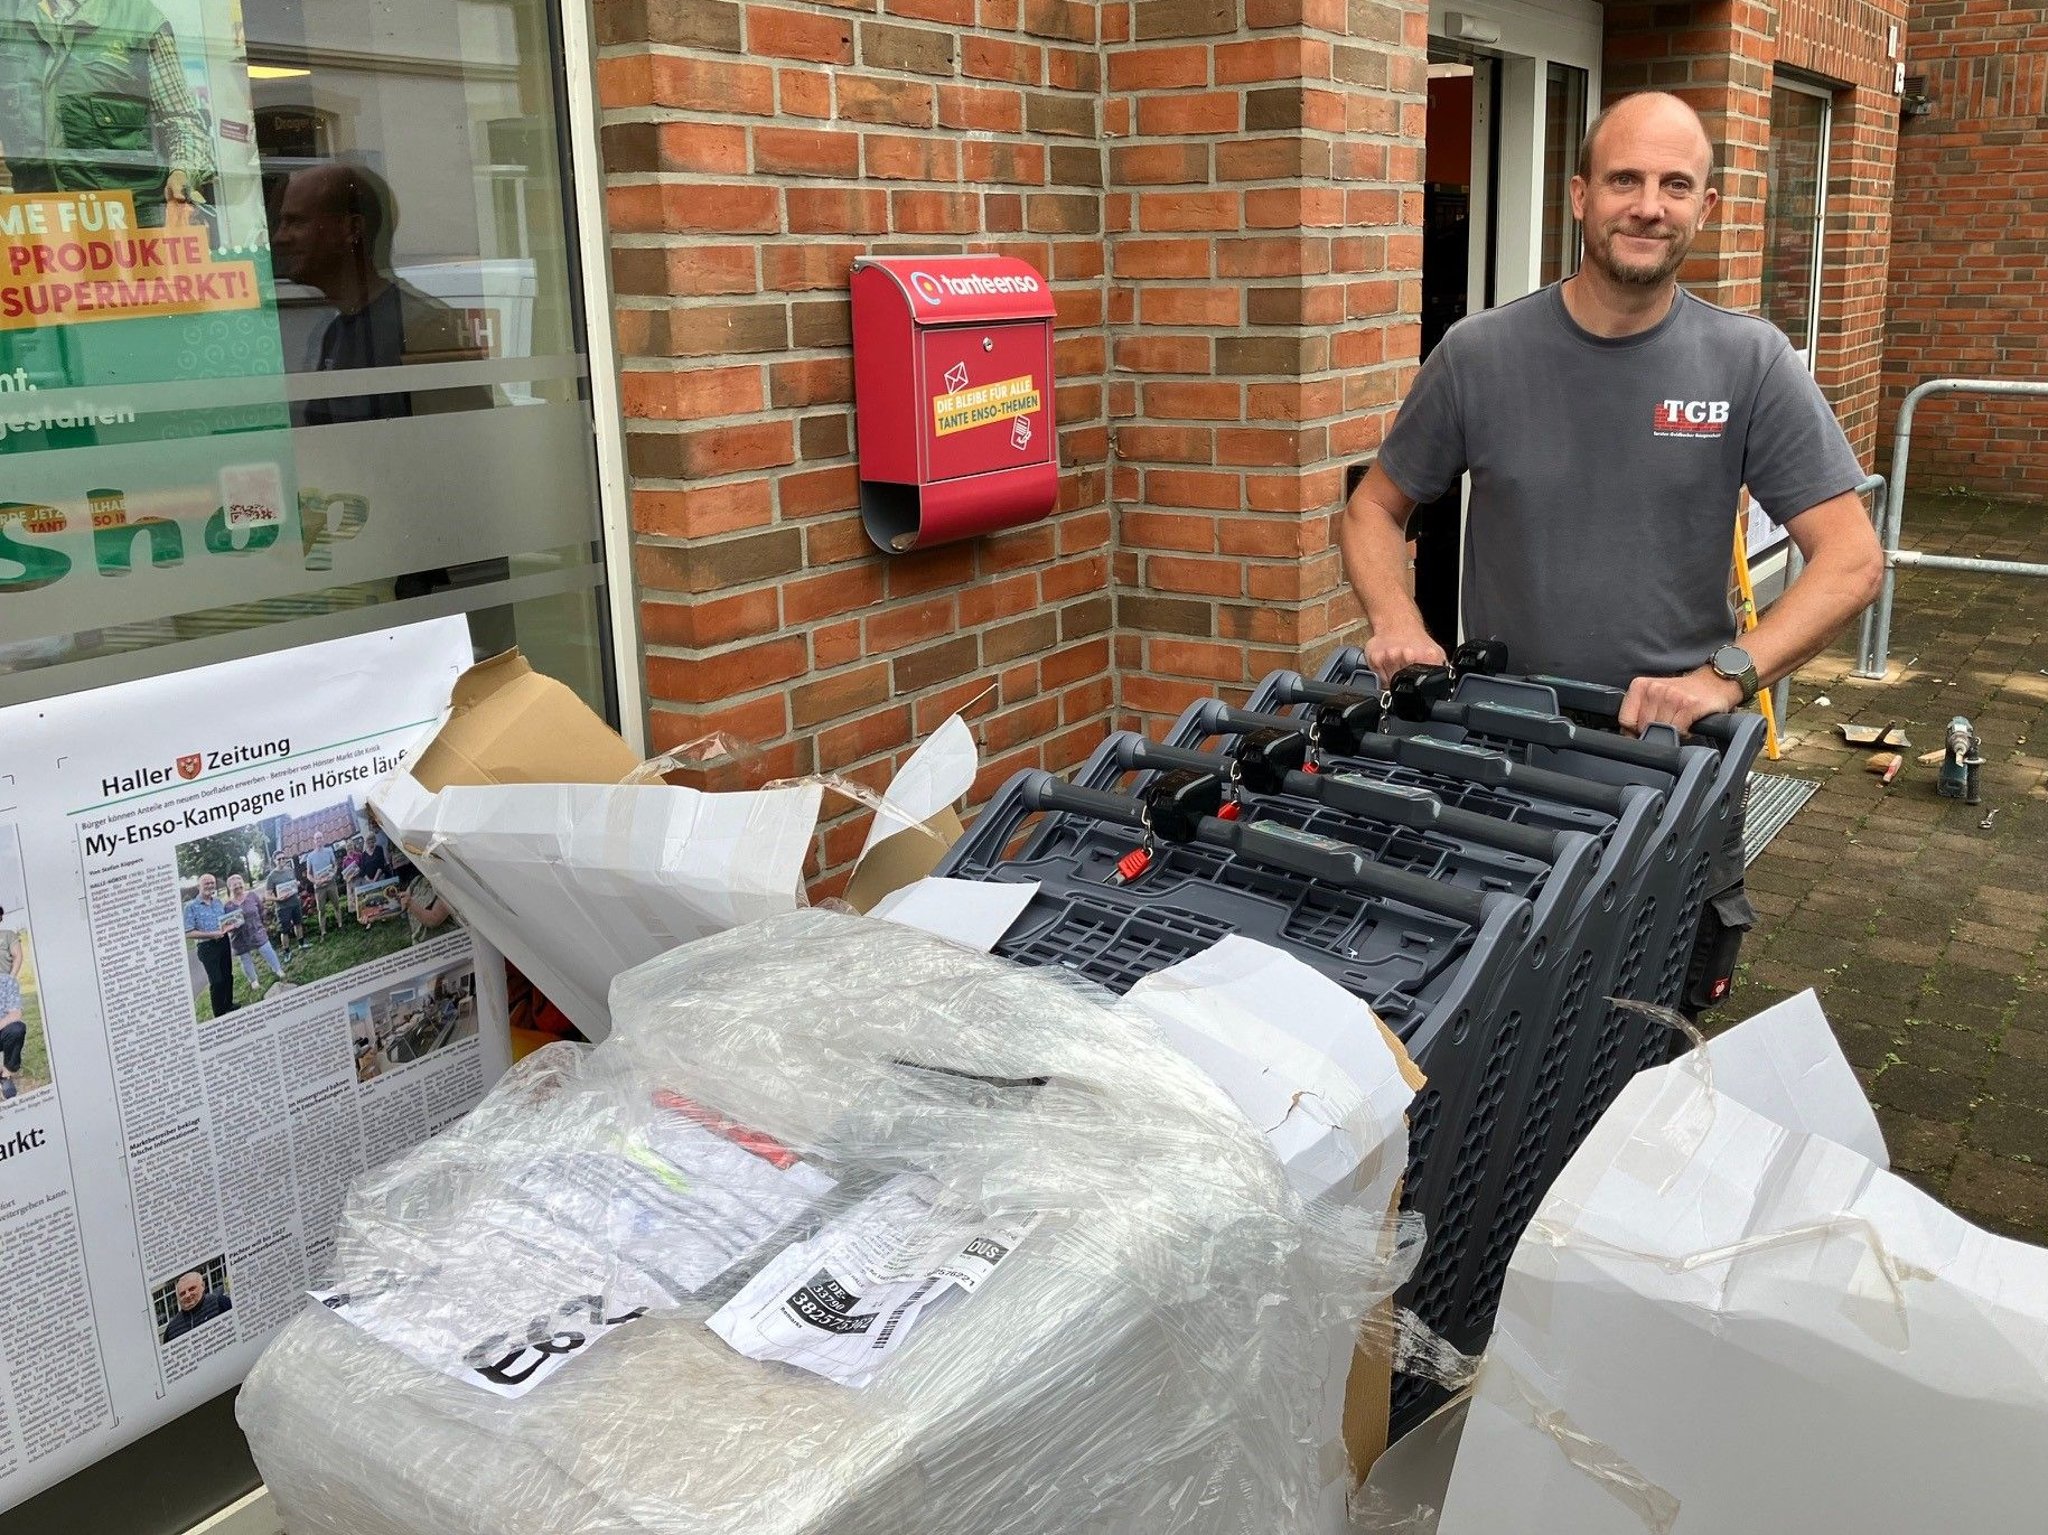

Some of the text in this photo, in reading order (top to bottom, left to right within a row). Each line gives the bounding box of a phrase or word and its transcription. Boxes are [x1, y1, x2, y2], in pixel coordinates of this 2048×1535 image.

[57, 193, 128, 232] FÜR
[8, 236, 201, 276] PRODUKTE
[0, 271, 249, 318] SUPERMARKT!
[942, 274, 1039, 295] tanteenso
[936, 379, 1032, 413] DIE BLEIBE FÜR ALLE
[1663, 399, 1730, 423] TGB
[938, 398, 1038, 430] TANTE ENSO-THEMEN
[29, 520, 66, 533] TANT
[102, 738, 290, 797] Haller Zeitung
[85, 788, 285, 857] My-Enso-Kampagne
[290, 780, 306, 799] in
[312, 765, 369, 793] Hörste
[966, 1240, 1000, 1259] DUS
[812, 1284, 846, 1312] 33790
[828, 1281, 846, 1300] DE-
